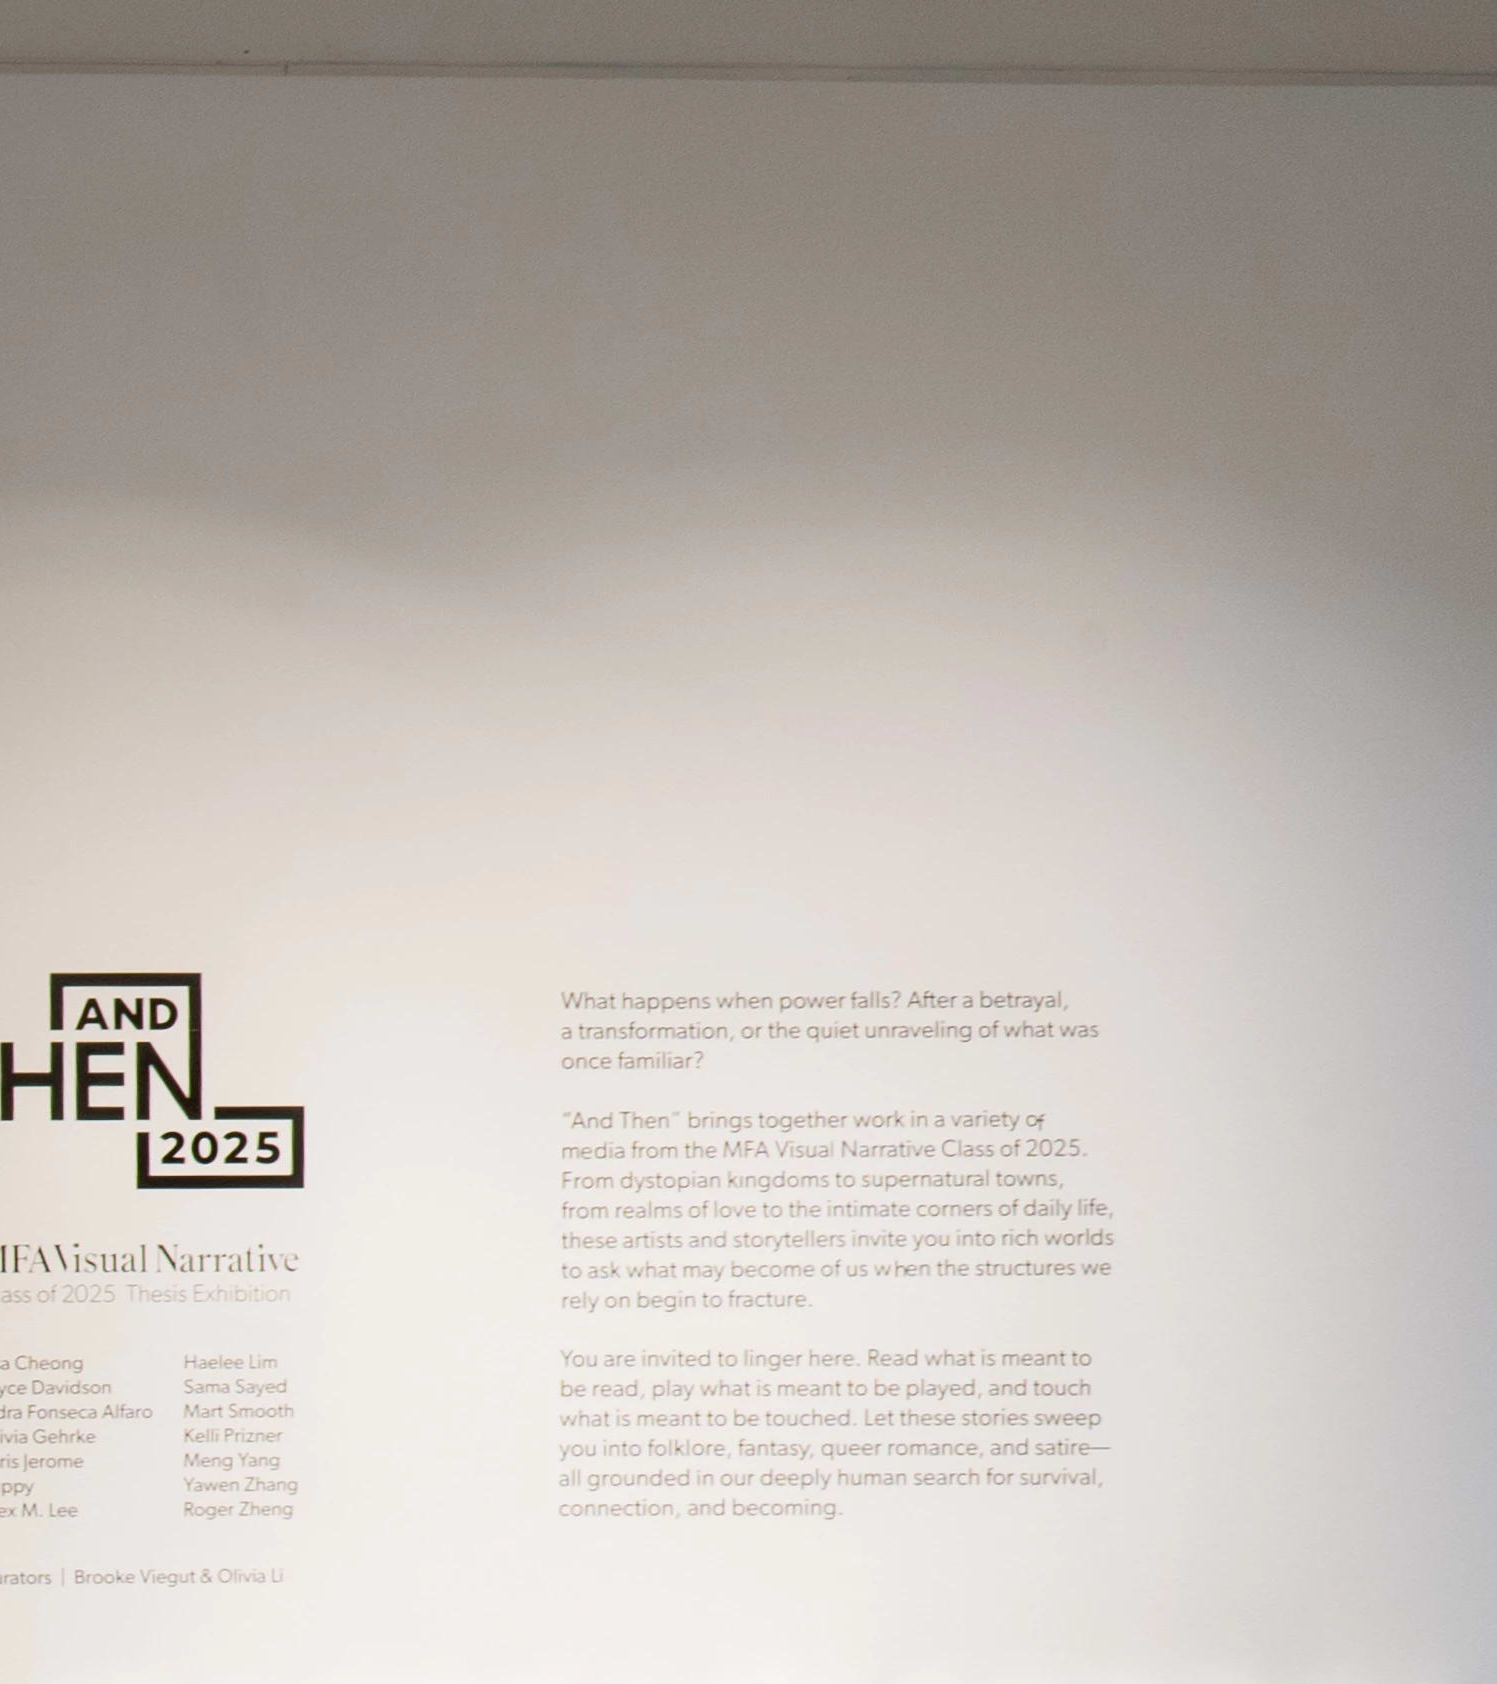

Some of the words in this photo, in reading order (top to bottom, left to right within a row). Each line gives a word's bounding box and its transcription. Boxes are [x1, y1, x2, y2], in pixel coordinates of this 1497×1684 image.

[561, 992, 616, 1009] What
[622, 992, 711, 1013] happens
[717, 992, 773, 1009] when
[780, 996, 846, 1013] power
[850, 990, 901, 1009] falls?
[907, 990, 957, 1008] After
[963, 996, 973, 1008] a
[980, 991, 1067, 1013] betrayal,
[76, 998, 179, 1030] AND
[561, 1027, 572, 1040] a
[578, 1021, 733, 1042] transformation,
[741, 1026, 762, 1039] or
[768, 1021, 801, 1039] the
[806, 1021, 859, 1043] quiet
[865, 1021, 972, 1043] unraveling
[978, 1020, 1000, 1038] of
[1004, 1020, 1054, 1038] what
[1060, 1025, 1099, 1038] was
[562, 1056, 612, 1070] once
[618, 1051, 703, 1069] familiar?
[688, 1112, 753, 1133] brings
[758, 1111, 847, 1133] together
[853, 1111, 904, 1128] work
[911, 1111, 928, 1127] in
[934, 1115, 945, 1128] a
[951, 1110, 1020, 1131] variety
[1025, 1114, 1045, 1131] of
[160, 1132, 282, 1165] 2025
[562, 1142, 625, 1160] media
[632, 1141, 678, 1159] from
[685, 1141, 717, 1159] the
[723, 1140, 769, 1158] MFA
[775, 1141, 833, 1158] Visual
[842, 1140, 936, 1158] Narrative
[942, 1139, 994, 1157] Class
[1000, 1139, 1021, 1157] of
[1026, 1138, 1086, 1157] 2025.
[562, 1171, 614, 1189] From
[620, 1171, 721, 1193] dystopian
[835, 1172, 855, 1188] to
[862, 1169, 989, 1192] supernatural
[995, 1171, 1063, 1189] towns,
[562, 1201, 608, 1219] from
[616, 1201, 683, 1219] realms
[688, 1200, 709, 1218] of
[714, 1200, 756, 1218] love
[763, 1202, 783, 1218] to
[789, 1200, 821, 1218] the
[827, 1200, 911, 1217] intimate
[916, 1204, 993, 1217] corners
[998, 1198, 1019, 1216] of
[1023, 1199, 1072, 1221] daily
[1078, 1198, 1113, 1219] life,
[562, 1232, 617, 1249] these
[623, 1231, 683, 1248] artists
[688, 1231, 727, 1248] and
[733, 1230, 845, 1252] storytellers
[852, 1230, 907, 1247] invite
[913, 1234, 950, 1251] you
[957, 1229, 996, 1247] into
[1002, 1228, 1038, 1246] rich
[1045, 1228, 1114, 1246] worlds
[54, 1243, 147, 1273] Visual
[156, 1243, 300, 1274] Narrative
[561, 1264, 582, 1279] to
[588, 1261, 620, 1279] ask
[627, 1261, 677, 1278] what
[683, 1265, 725, 1282] may
[731, 1261, 815, 1279] become
[821, 1259, 841, 1277] of
[846, 1264, 868, 1277] us
[874, 1260, 931, 1277] when
[936, 1259, 970, 1277] the
[975, 1260, 1076, 1276] structures
[1081, 1262, 1112, 1276] we
[37, 1284, 57, 1303] of
[62, 1284, 115, 1303] 2025
[125, 1284, 187, 1303] Thesis
[193, 1284, 290, 1302] Exhibition
[562, 1292, 599, 1313] rely
[605, 1296, 630, 1308] on
[637, 1290, 696, 1312] begin
[702, 1292, 723, 1308] to
[728, 1289, 812, 1308] fracture.
[14, 1355, 83, 1374] Cheong
[184, 1355, 244, 1369] Haelee
[249, 1354, 277, 1369] Lim
[32, 1380, 111, 1395] Davidson
[184, 1379, 230, 1394] Sama
[236, 1379, 287, 1397] Sayed
[27, 1404, 97, 1419] Fonseca
[102, 1404, 153, 1419] Alfaro
[184, 1404, 223, 1418] Mart
[229, 1403, 294, 1418] Smooth
[32, 1429, 96, 1444] Gehrke
[184, 1428, 219, 1443] Kelli
[224, 1428, 283, 1443] Prizner
[23, 1454, 84, 1472] Jerome
[184, 1453, 233, 1471] Meng
[238, 1452, 280, 1471] Yang
[184, 1477, 240, 1492] Yawen
[244, 1476, 298, 1495] Zhang
[22, 1503, 43, 1517] M.
[49, 1503, 78, 1518] Lee
[184, 1502, 234, 1520] Roger
[238, 1501, 293, 1520] Zheng
[74, 1569, 135, 1584] Brooke
[140, 1569, 195, 1587] Viegut
[200, 1568, 212, 1584] &
[217, 1568, 266, 1583] Olivia
[272, 1568, 283, 1583] Li
